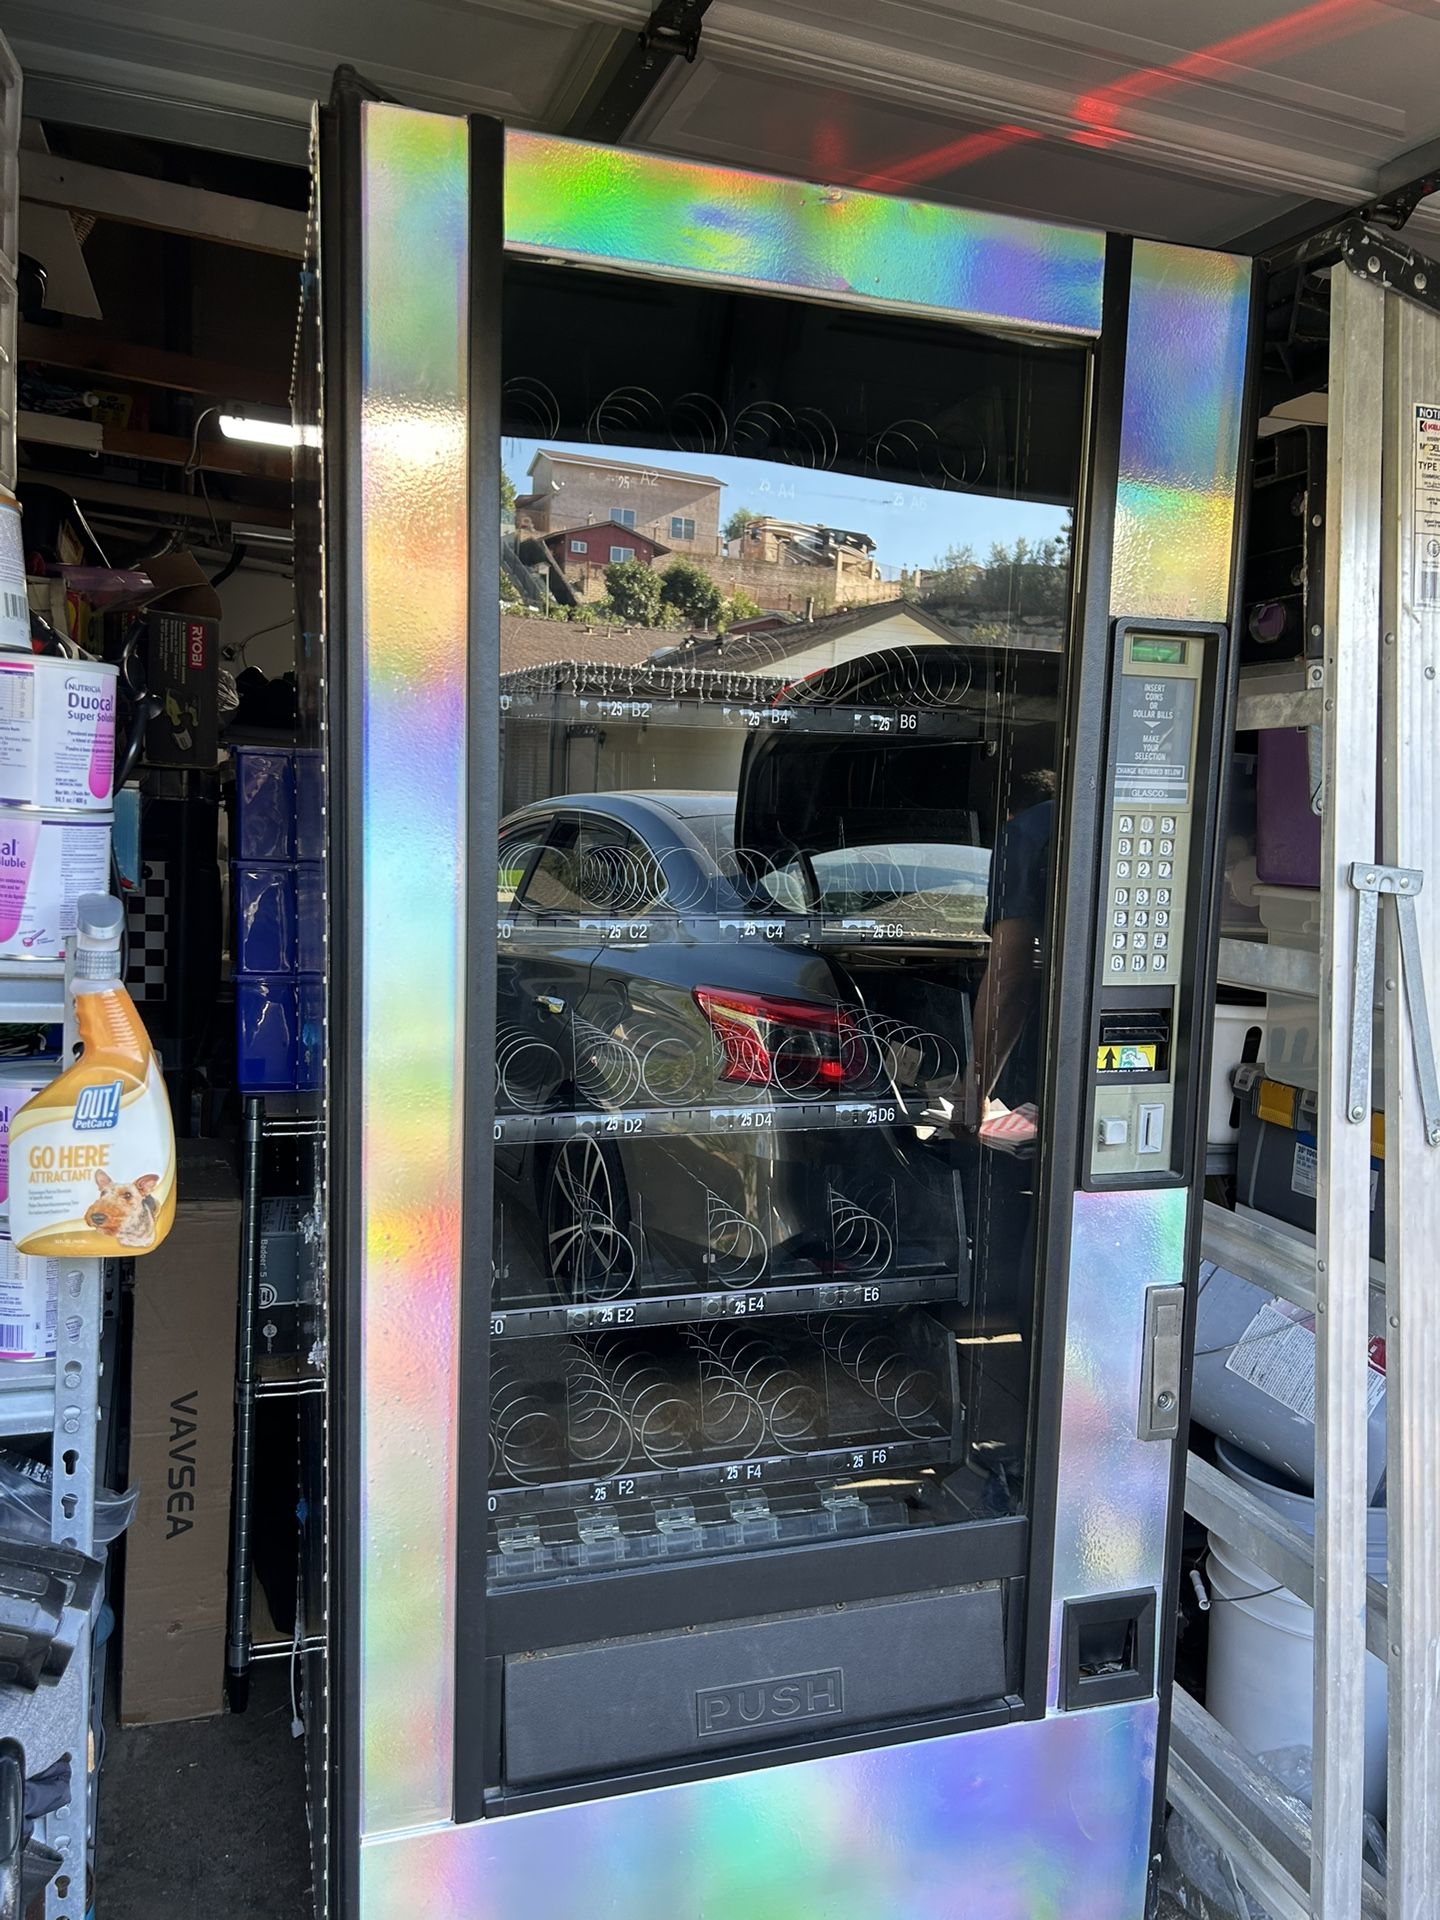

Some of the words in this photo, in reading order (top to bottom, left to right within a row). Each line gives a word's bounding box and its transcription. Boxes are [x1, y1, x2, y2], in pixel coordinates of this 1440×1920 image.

[1418, 461, 1437, 471] TYPE
[192, 626, 203, 667] RYOBI
[66, 683, 102, 693] NUTRICIA
[1144, 684, 1166, 692] INSERT
[68, 692, 114, 711] Duocal
[1145, 693, 1163, 701] COINS
[632, 702, 650, 718] B2
[1149, 702, 1158, 710] OR
[68, 710, 95, 722] Super
[771, 709, 789, 725] B4
[1133, 709, 1156, 719] DOLLAR
[1157, 711, 1174, 719] BILLS
[900, 714, 917, 729] B6
[1143, 735, 1160, 743] MAKE
[1143, 744, 1159, 752] YOUR
[1135, 752, 1167, 760] SELECTION
[1137, 767, 1163, 775] RETURNED
[1164, 768, 1182, 776] BELOW
[1132, 789, 1164, 798] GLASCO
[1120, 818, 1129, 829] A
[1142, 819, 1150, 831] 0
[1163, 819, 1171, 831] 5
[1120, 841, 1128, 852] B
[1142, 841, 1148, 852] 1
[1162, 841, 1169, 853] 6
[1118, 863, 1126, 875] C
[1139, 863, 1147, 875] 2
[1160, 864, 1167, 875] 7
[1117, 890, 1125, 902] D
[1138, 890, 1145, 902] 3
[1159, 890, 1166, 902] 8
[1116, 912, 1123, 924] E
[1136, 912, 1143, 924] 4
[1157, 912, 1164, 924] 9
[629, 924, 648, 939] C2
[766, 923, 783, 938] C4
[1114, 934, 1122, 946] F
[1156, 934, 1163, 946] #
[1113, 957, 1121, 969] G
[1133, 957, 1141, 969] H
[1155, 957, 1162, 969] J
[78, 1082, 122, 1120] OUT!
[755, 1112, 772, 1127] D4
[879, 1107, 895, 1122] D6
[75, 1118, 113, 1129] PetCare
[624, 1118, 643, 1133] D2
[29, 1146, 54, 1169] GO
[59, 1144, 110, 1168] HERE
[28, 1168, 93, 1184] ATTRACTANT
[864, 1287, 880, 1302] E6
[748, 1297, 764, 1312] E4
[617, 1308, 634, 1323] E2
[872, 1451, 887, 1464] F6
[165, 1390, 199, 1540] VAVSEA
[747, 1464, 762, 1479] F4
[618, 1480, 634, 1495] F2
[704, 1676, 836, 1730] PUSH
